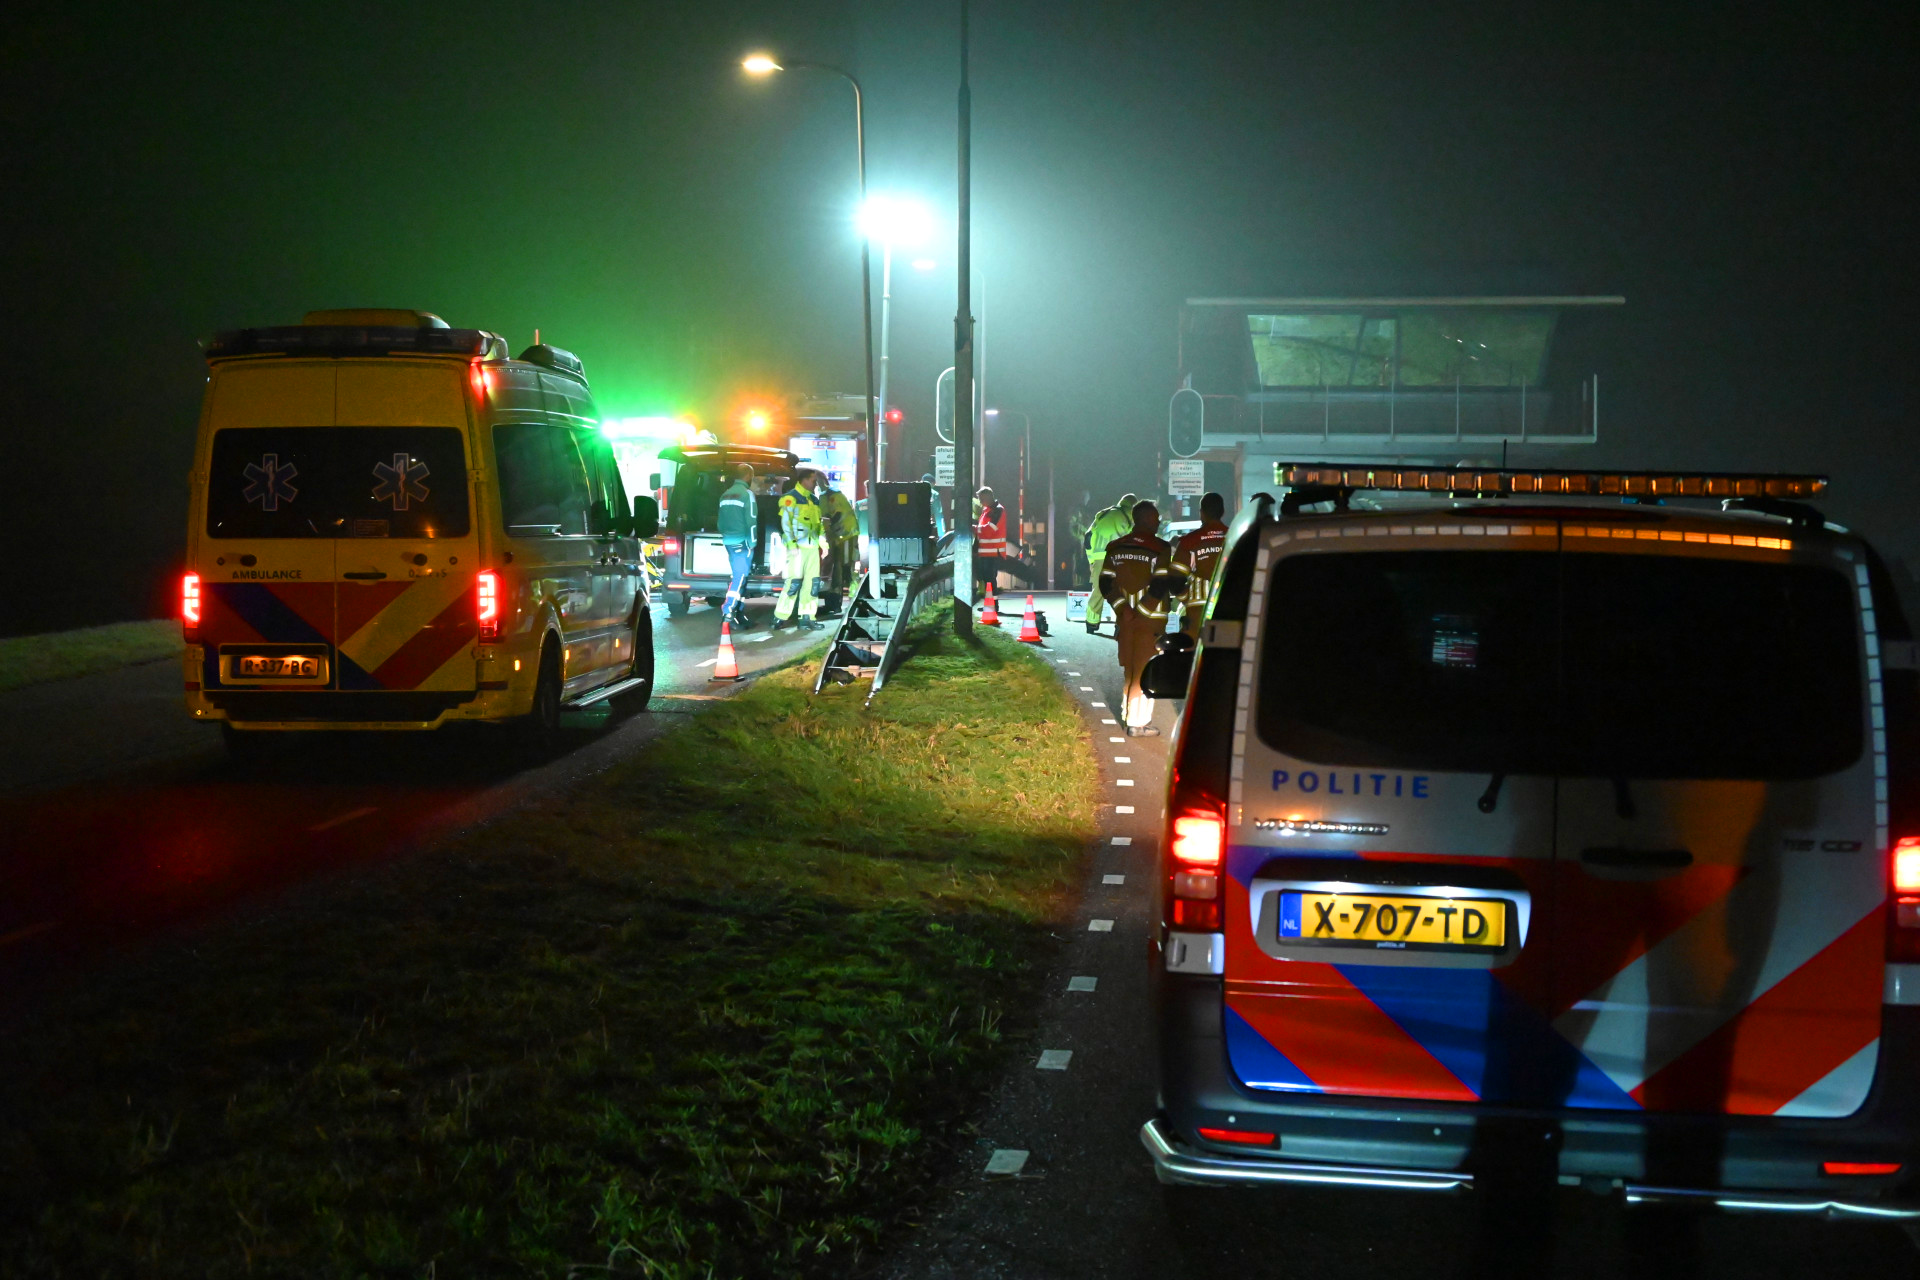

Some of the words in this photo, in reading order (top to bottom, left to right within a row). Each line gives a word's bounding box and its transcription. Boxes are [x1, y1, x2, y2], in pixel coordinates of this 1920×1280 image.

[1197, 546, 1223, 556] BRAND
[1114, 553, 1150, 562] BRANDWEER
[232, 569, 302, 579] AMBULANCE
[244, 659, 312, 674] R-337-BG
[1272, 769, 1430, 799] POLITIE
[1283, 919, 1298, 930] NL
[1314, 901, 1487, 940] X-707-TD
